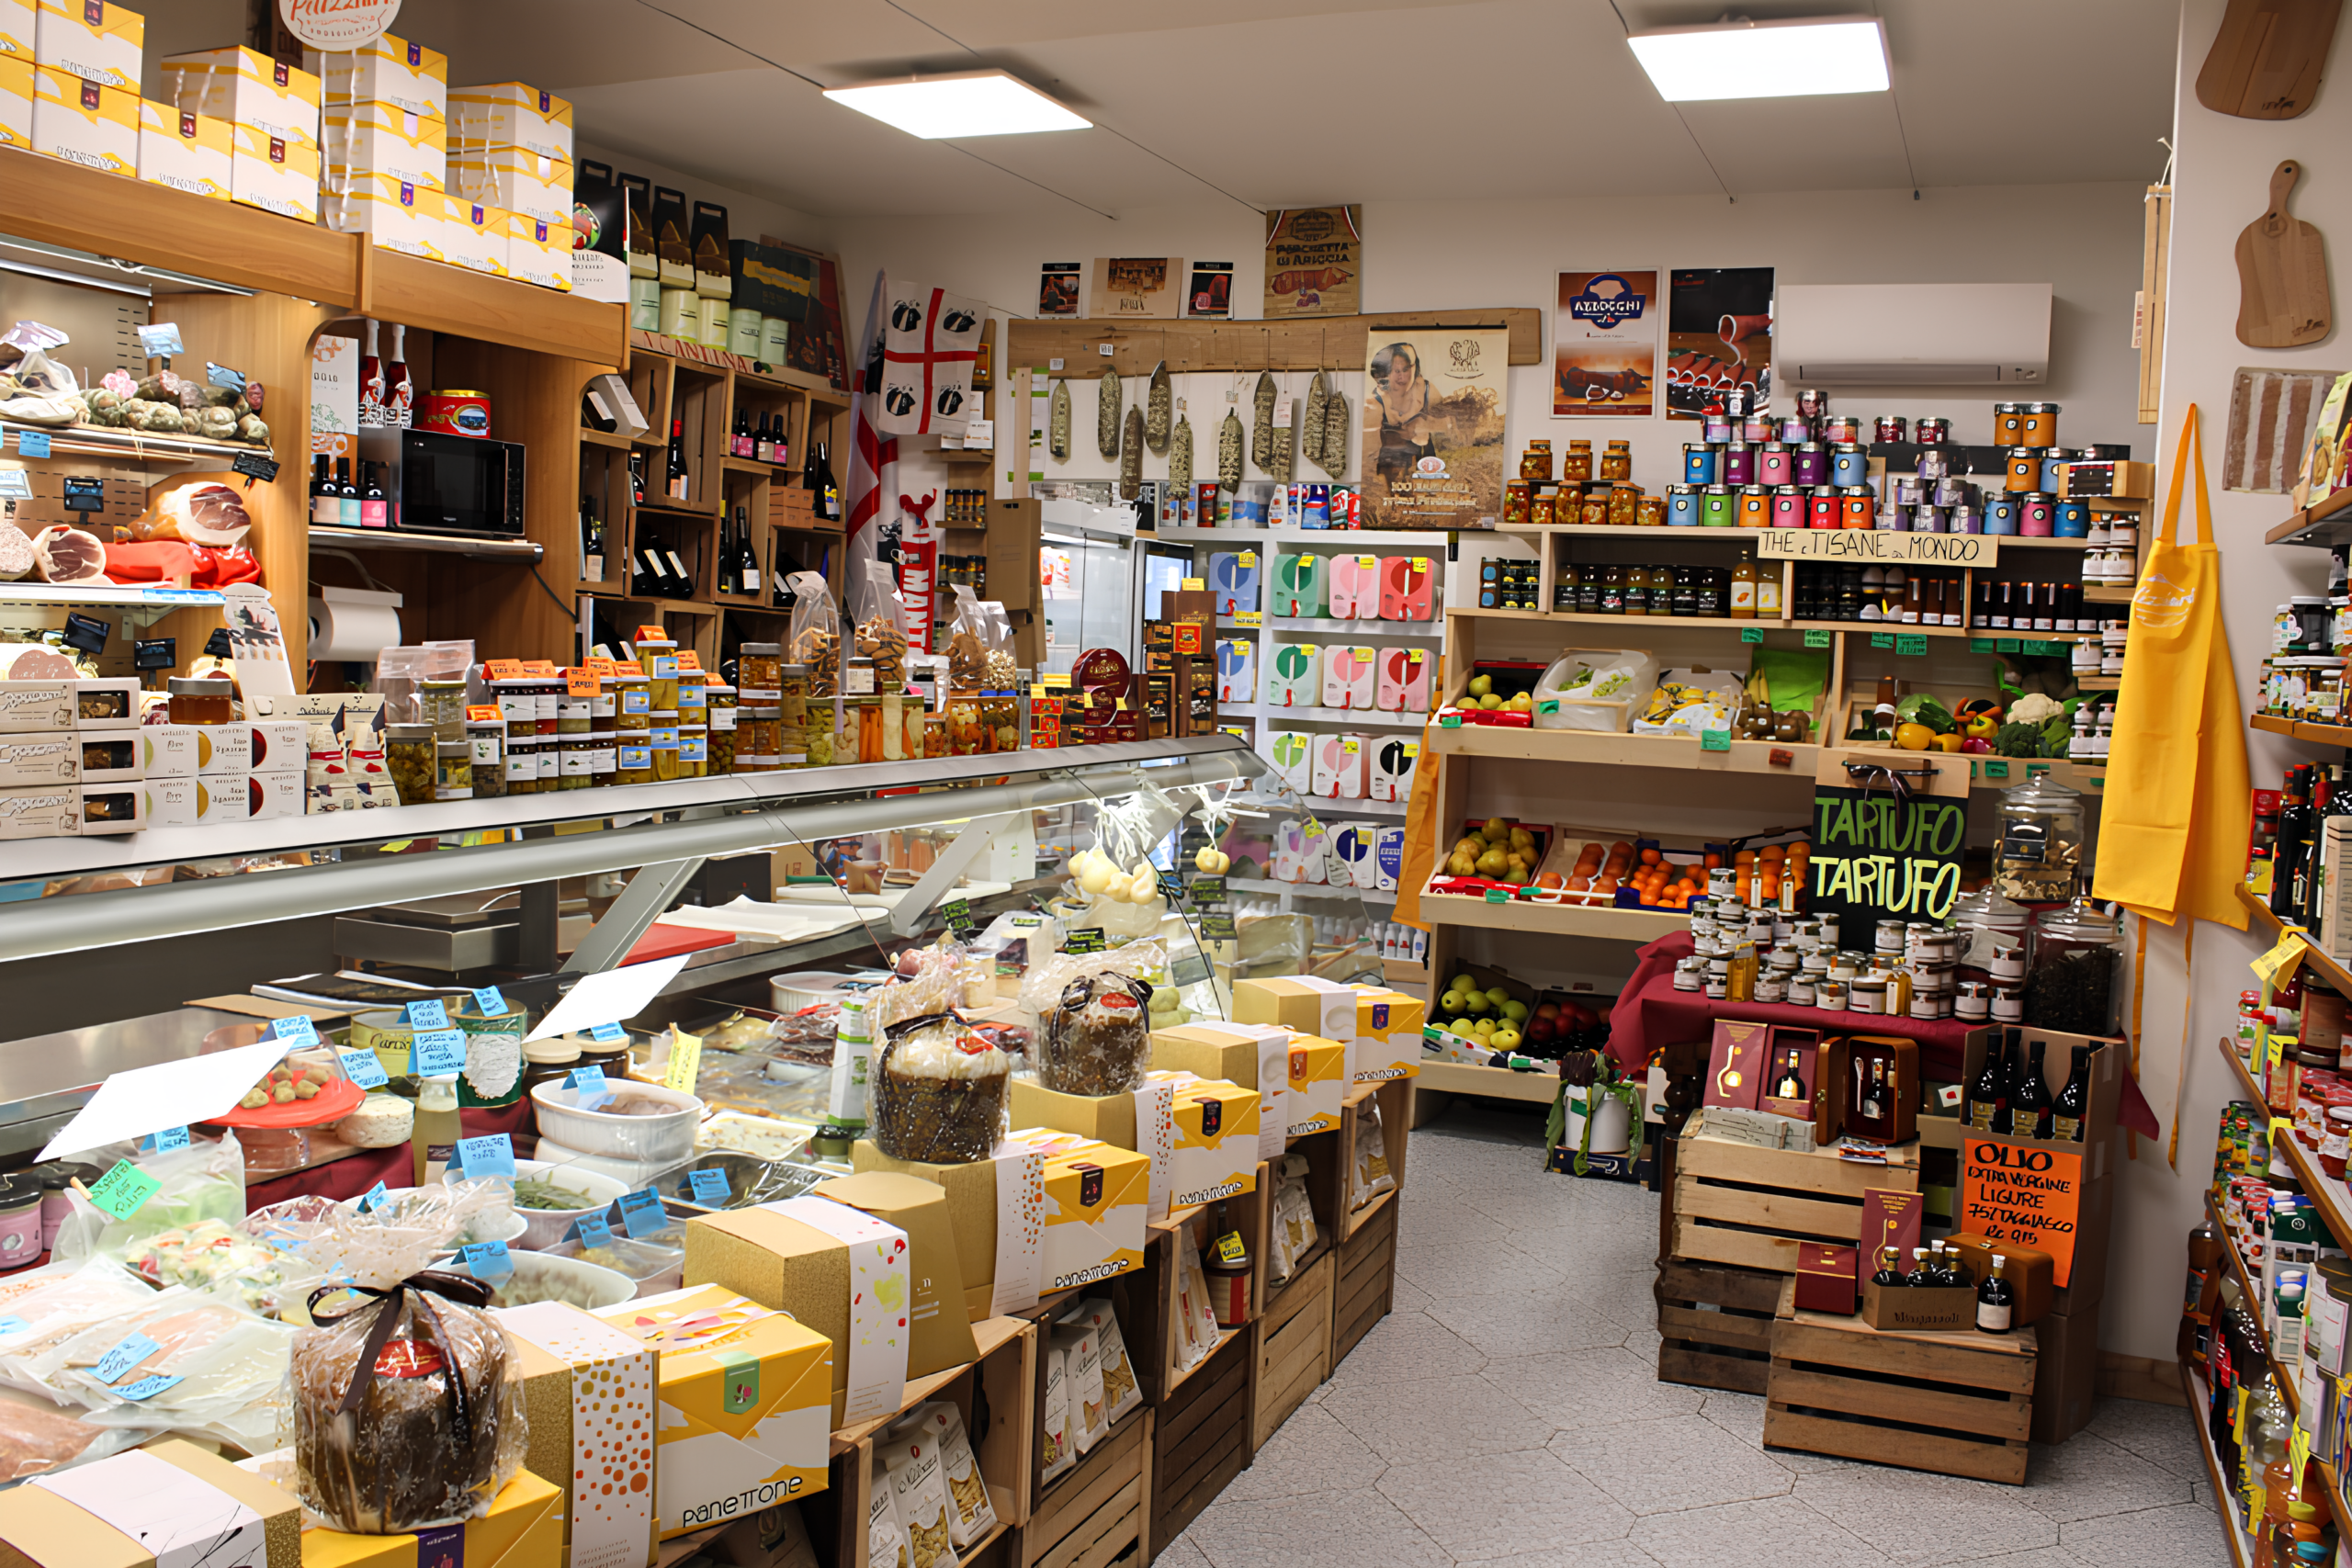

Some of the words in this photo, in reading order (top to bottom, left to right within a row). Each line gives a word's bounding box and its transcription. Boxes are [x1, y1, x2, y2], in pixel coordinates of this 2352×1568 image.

[1762, 532, 1796, 553] THE
[1812, 532, 1891, 557] TISANE
[1908, 536, 1980, 561] MONDO
[903, 569, 930, 649] MANT
[1815, 796, 1964, 855] TARTUFO
[1809, 854, 1961, 919] TARTUFO
[1974, 1143, 2053, 1171] OLIO
[1980, 1183, 2045, 1209] LIGURE
